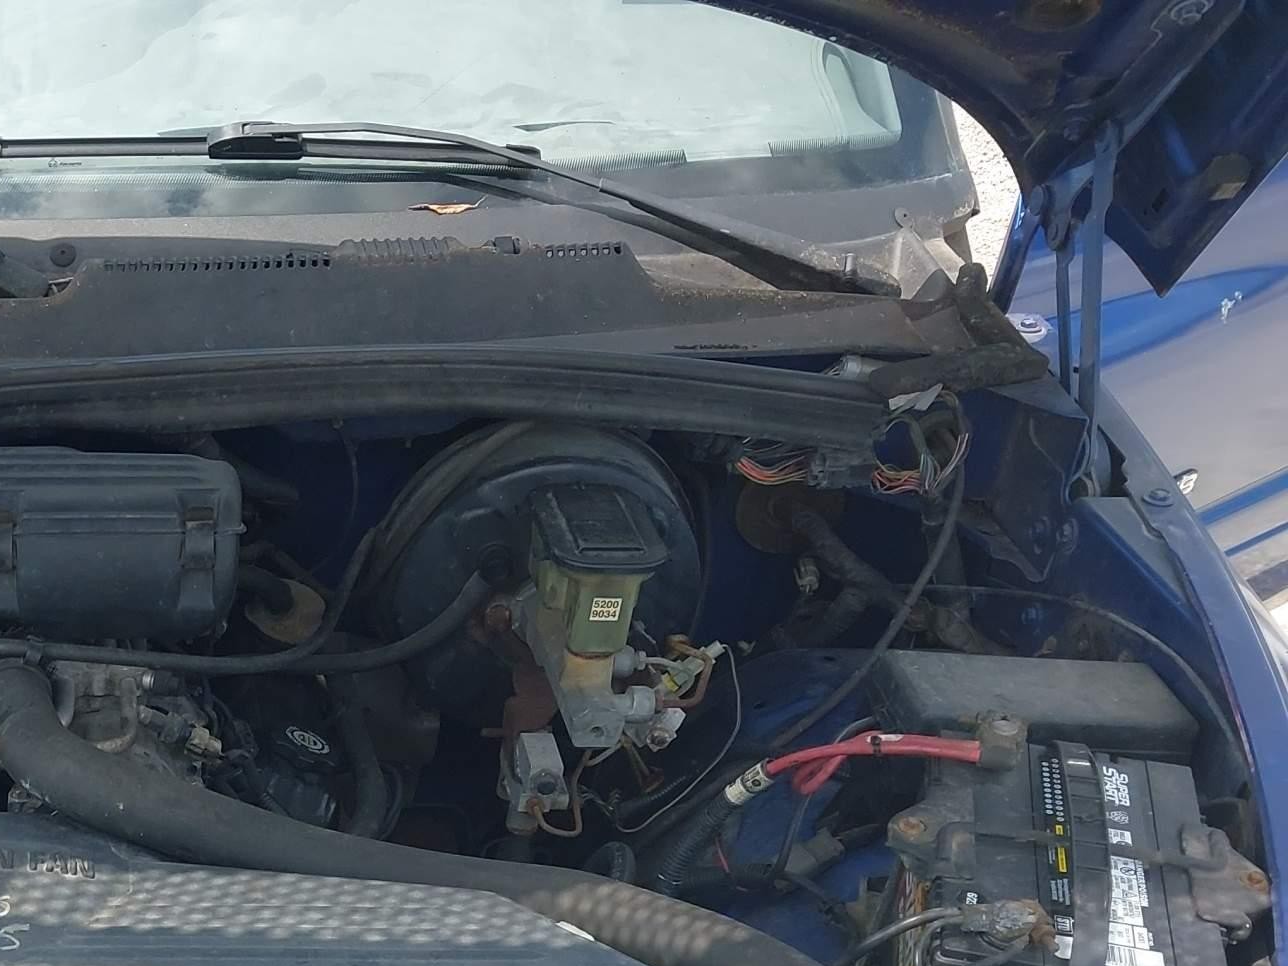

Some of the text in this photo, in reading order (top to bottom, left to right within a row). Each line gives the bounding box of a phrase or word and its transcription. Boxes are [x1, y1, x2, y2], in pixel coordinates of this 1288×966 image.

[591, 609, 617, 619] 9034
[593, 599, 620, 610] 5200
[1102, 765, 1120, 807] START
[1116, 773, 1131, 807] SUPER
[26, 850, 97, 881] FAN
